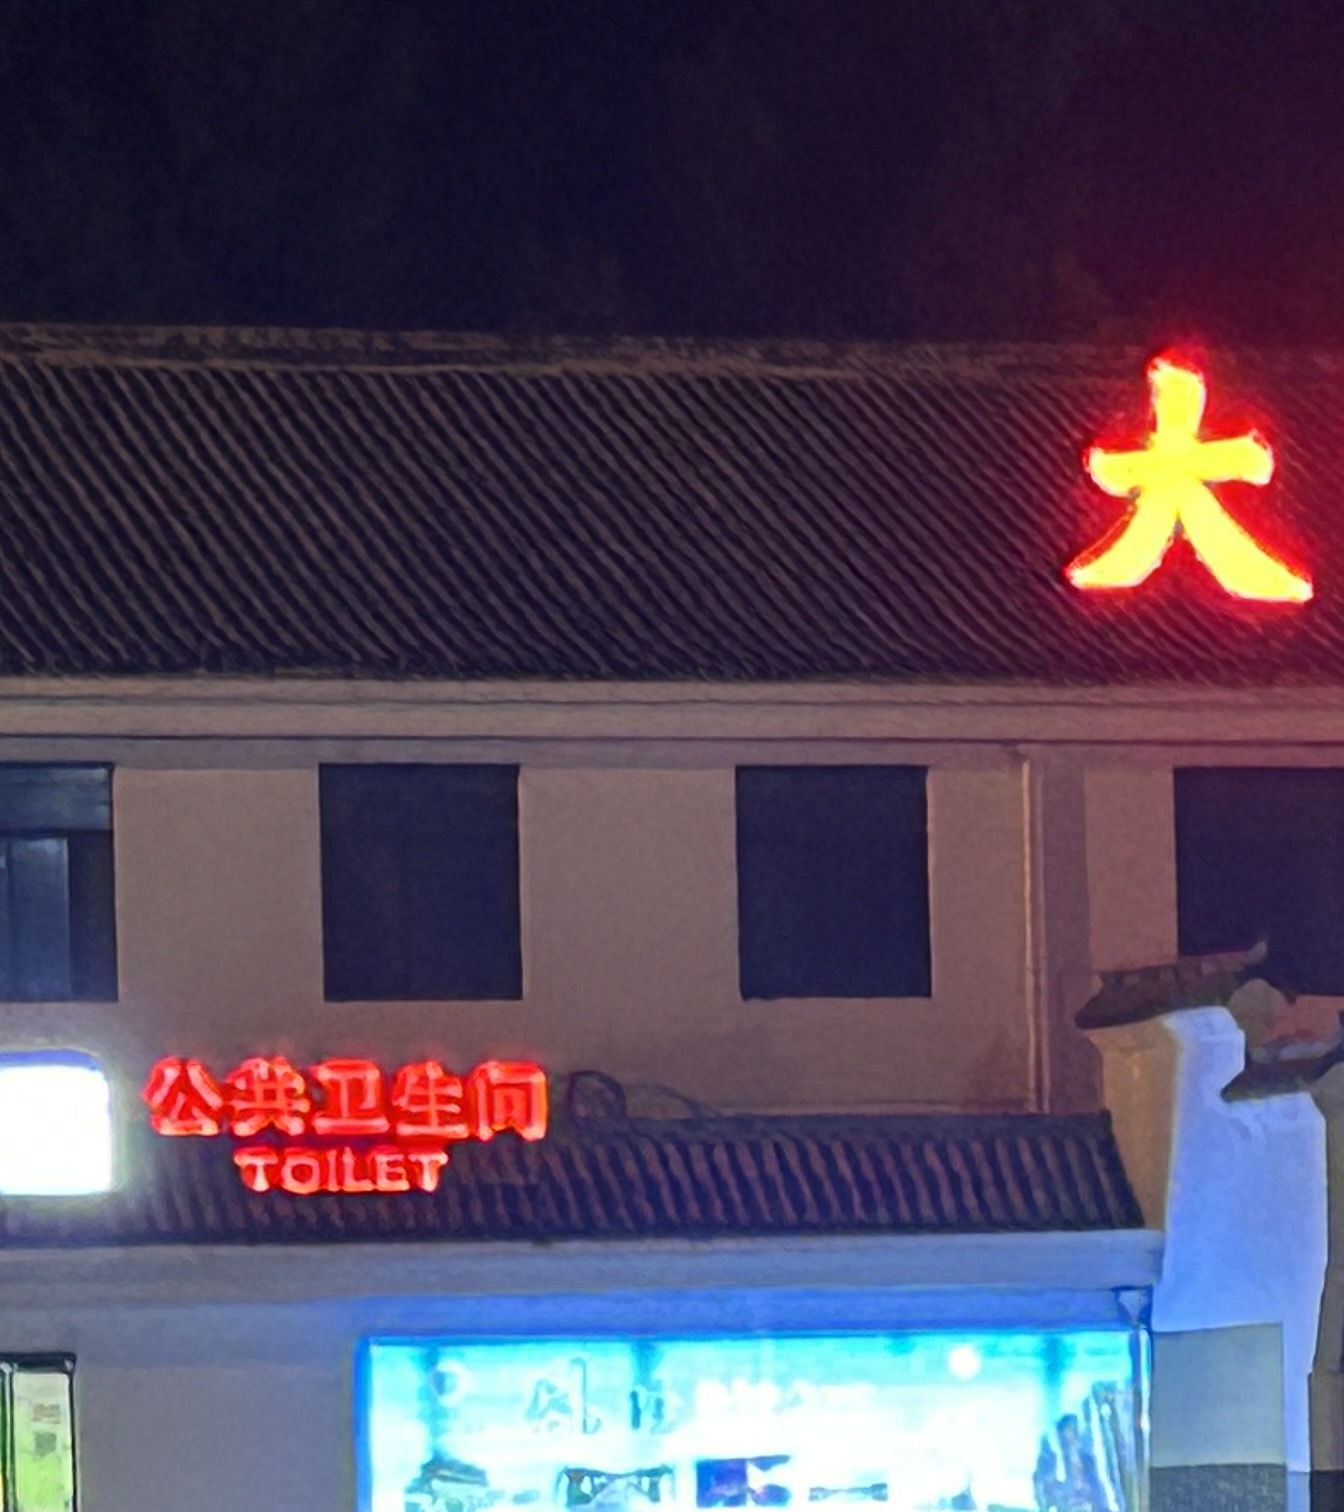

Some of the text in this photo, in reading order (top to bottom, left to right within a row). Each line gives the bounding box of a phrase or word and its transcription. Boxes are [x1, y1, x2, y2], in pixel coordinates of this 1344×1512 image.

[144, 1055, 549, 1141] 公共卫生间
[234, 1147, 450, 1193] TOILET
